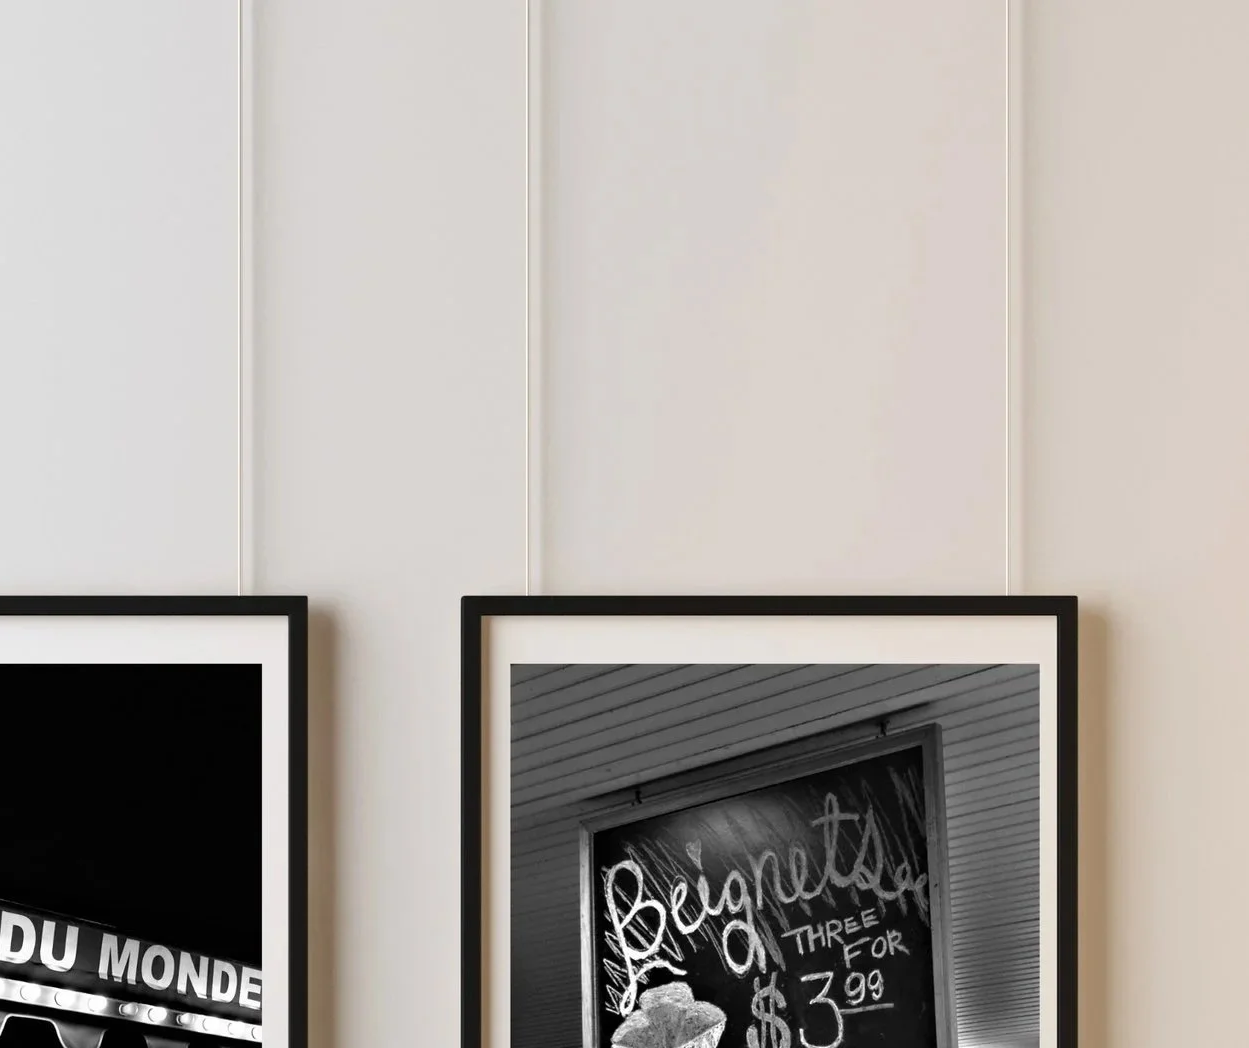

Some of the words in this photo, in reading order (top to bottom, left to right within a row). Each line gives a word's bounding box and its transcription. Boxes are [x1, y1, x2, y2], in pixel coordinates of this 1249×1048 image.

[603, 791, 927, 1017] Beignets
[781, 907, 879, 956] THREE
[98, 932, 262, 1010] MONDE
[844, 929, 910, 969] FOR
